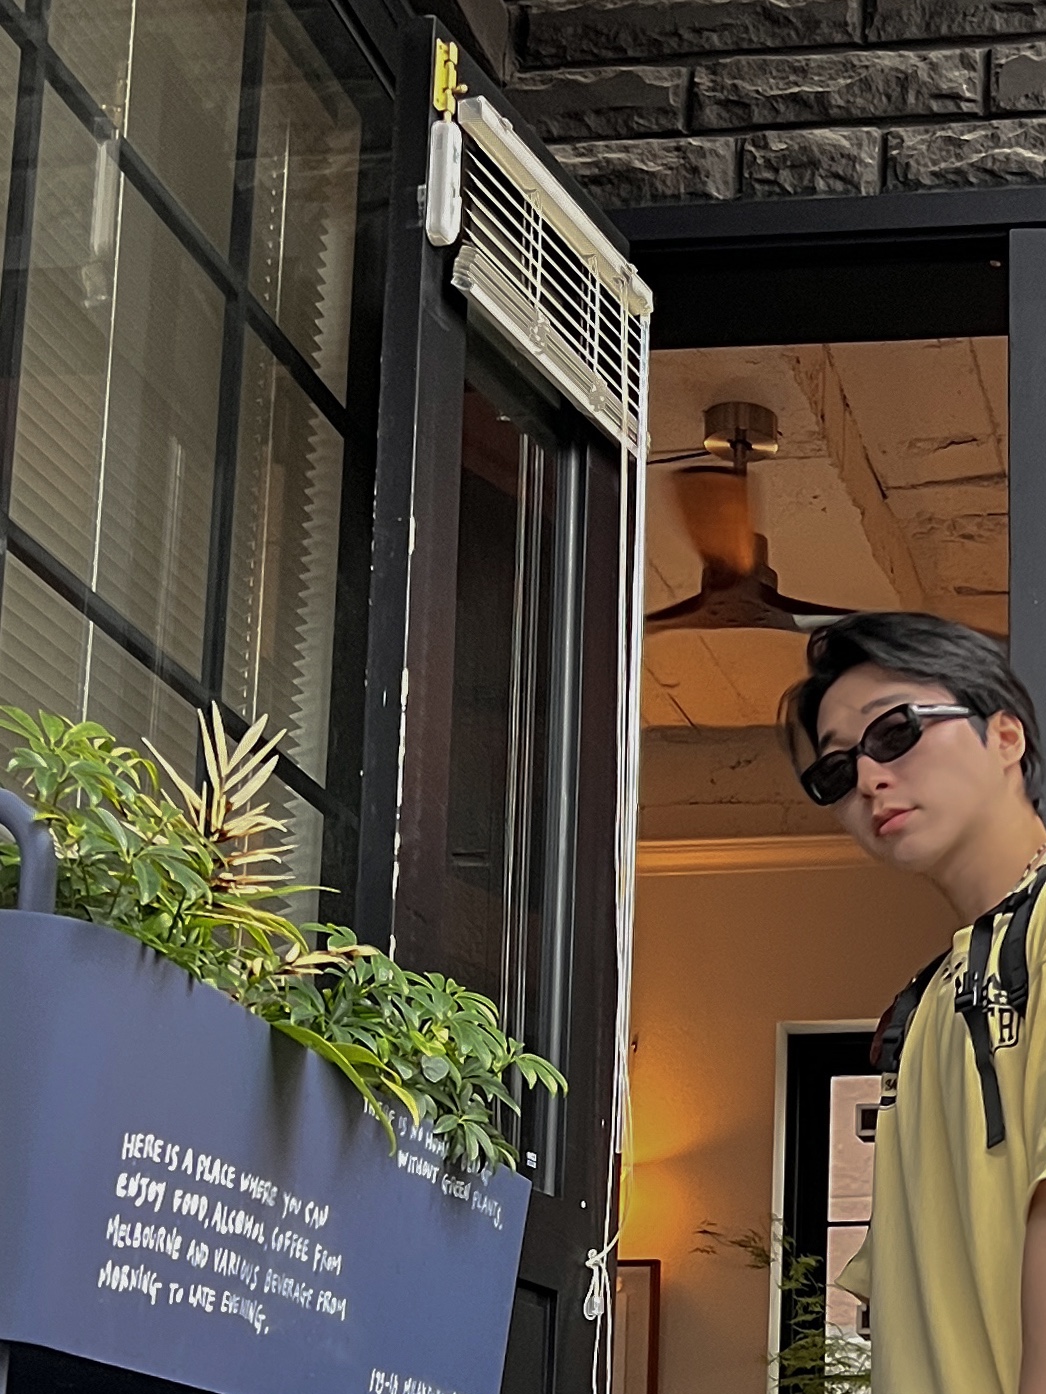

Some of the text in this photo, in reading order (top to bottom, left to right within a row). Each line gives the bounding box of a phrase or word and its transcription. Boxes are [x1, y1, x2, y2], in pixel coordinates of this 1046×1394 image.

[116, 1172, 166, 1213] ENJOY
[173, 1189, 209, 1229] FOOD,
[271, 1226, 309, 1262] COFFEE
[313, 1243, 342, 1276] FROM
[121, 1132, 329, 1230] HERE IS A PLACE WHERE YOU CAN
[397, 1150, 440, 1184] WITHOUT
[441, 1173, 472, 1202] GREEN
[97, 1259, 163, 1306] MORNING
[169, 1282, 184, 1305] TO
[188, 1284, 216, 1313] LATE
[106, 1214, 347, 1321] MELBOURNE AND VARIOUS BEVERAGE FROM
